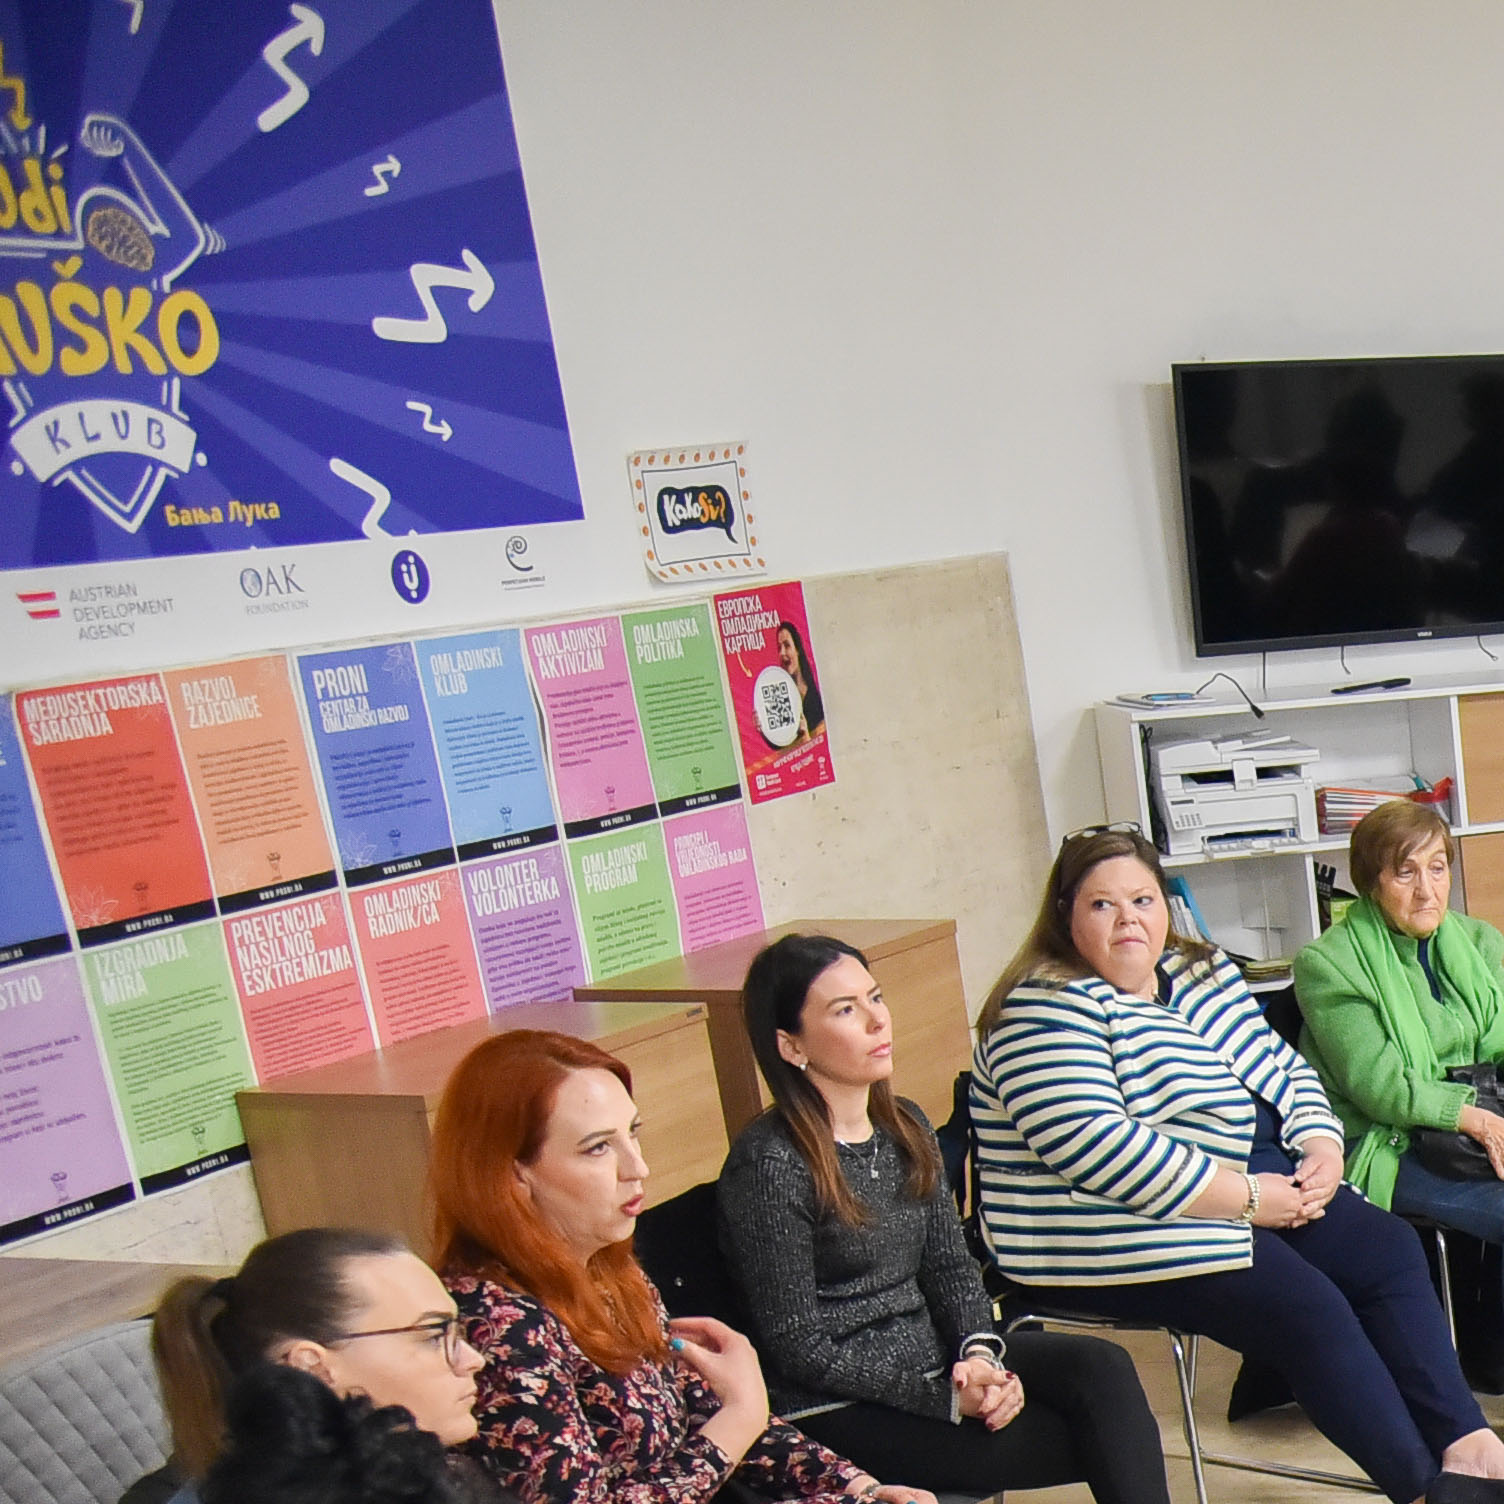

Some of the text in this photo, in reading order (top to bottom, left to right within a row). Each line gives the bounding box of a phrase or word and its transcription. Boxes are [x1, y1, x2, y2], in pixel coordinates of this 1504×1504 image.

[44, 408, 167, 456] KLUB
[164, 500, 281, 527] Бања Лука
[69, 583, 138, 602] AUSTRIAN
[239, 563, 306, 599] OAK
[73, 598, 174, 623] DEVELOPMENT
[246, 600, 310, 616] FOUNDATION
[717, 594, 763, 619] ЕВРОПСКА
[79, 622, 136, 641] AGENCY
[633, 617, 700, 645] OMLADINSKA
[720, 610, 781, 637] ОМЛАДИНСКА
[531, 626, 608, 658] OMLADINSKI
[636, 640, 685, 665] POLITIKA
[724, 631, 766, 655] КАРТИЦА
[430, 646, 504, 676] OMLADINSKI
[538, 648, 605, 681] AKTIVIZAM
[181, 675, 238, 706] RAZVOJ
[311, 663, 370, 700] PRONI
[434, 672, 468, 697] KLUB
[23, 680, 165, 724] MEĐUSEKTORSKA
[187, 695, 263, 729] ZAJEDNICE
[319, 697, 370, 718] CENTAR ZA
[28, 712, 115, 746] SARADNJA
[322, 705, 410, 734] OMLADINSKI RAZVOJ
[582, 840, 648, 875] OMLADINSKI
[467, 858, 540, 895] VOLONTER
[584, 863, 638, 895] PROGRAM
[364, 879, 441, 917] OMLADINSKI
[471, 876, 560, 917] VOLONTERKA
[231, 901, 327, 947] PREVENCIJA
[367, 902, 441, 939] RADNIK/CA
[93, 933, 190, 978] IZGRADNJA
[236, 929, 315, 972] NASILNOG
[242, 944, 354, 997] ESKTREMIZMA
[101, 970, 149, 1006] MIRA
